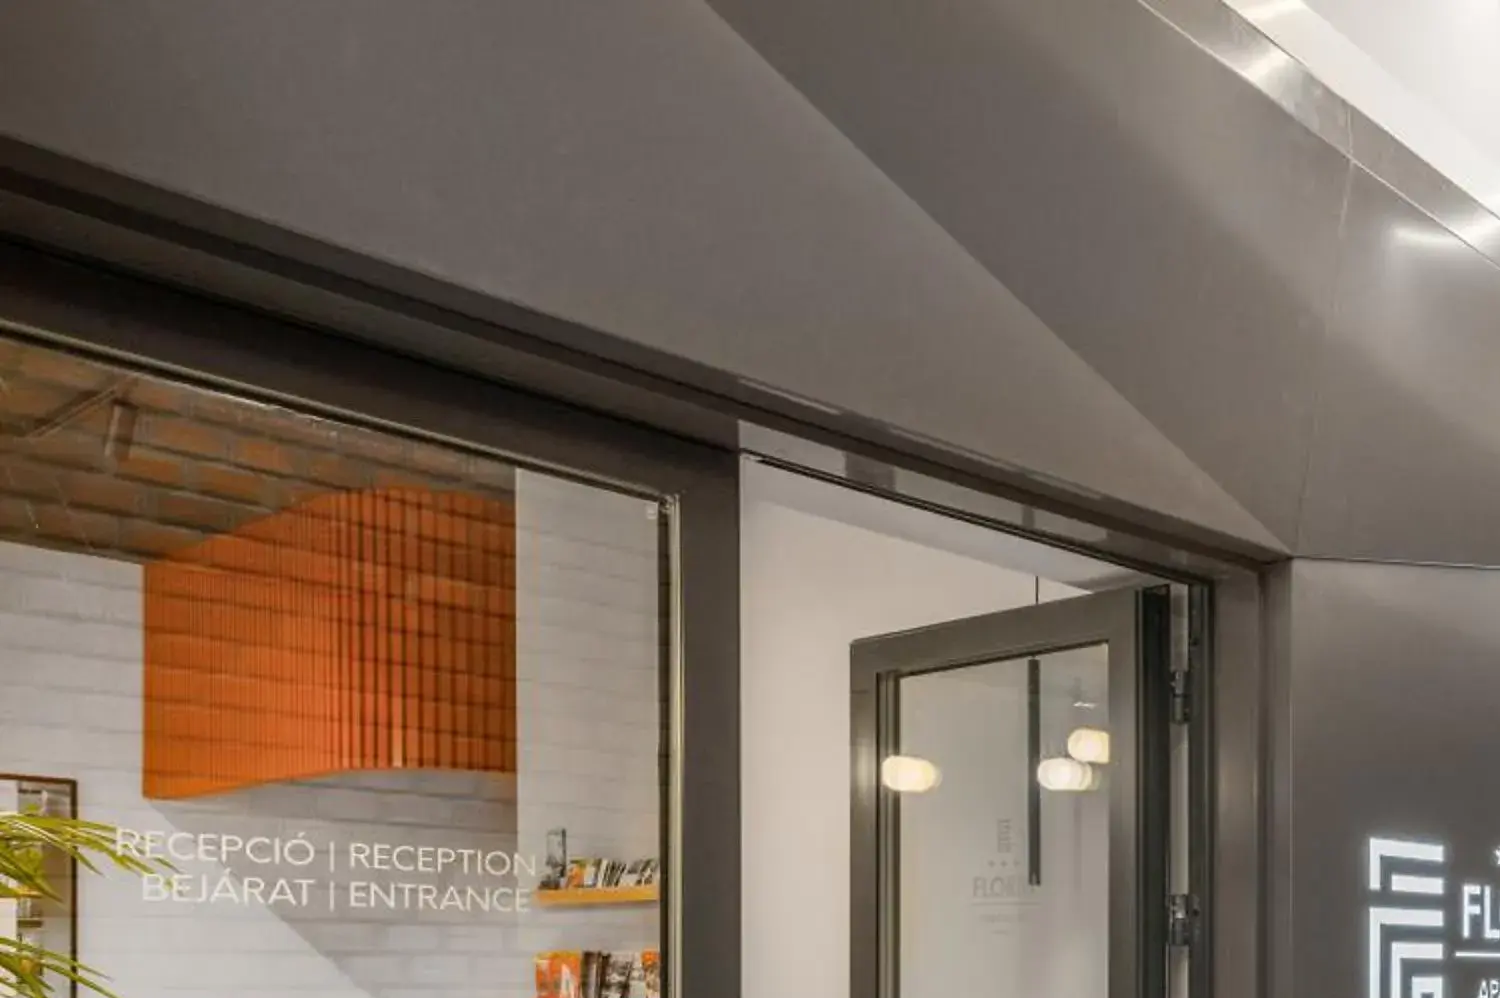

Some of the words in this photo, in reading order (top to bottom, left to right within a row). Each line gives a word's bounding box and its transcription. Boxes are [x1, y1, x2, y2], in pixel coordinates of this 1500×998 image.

[114, 829, 315, 867] RECEPCIÓ
[348, 842, 536, 877] RECEPTION
[142, 868, 315, 906] BEJÁRAT
[348, 881, 530, 914] ENTRANCE
